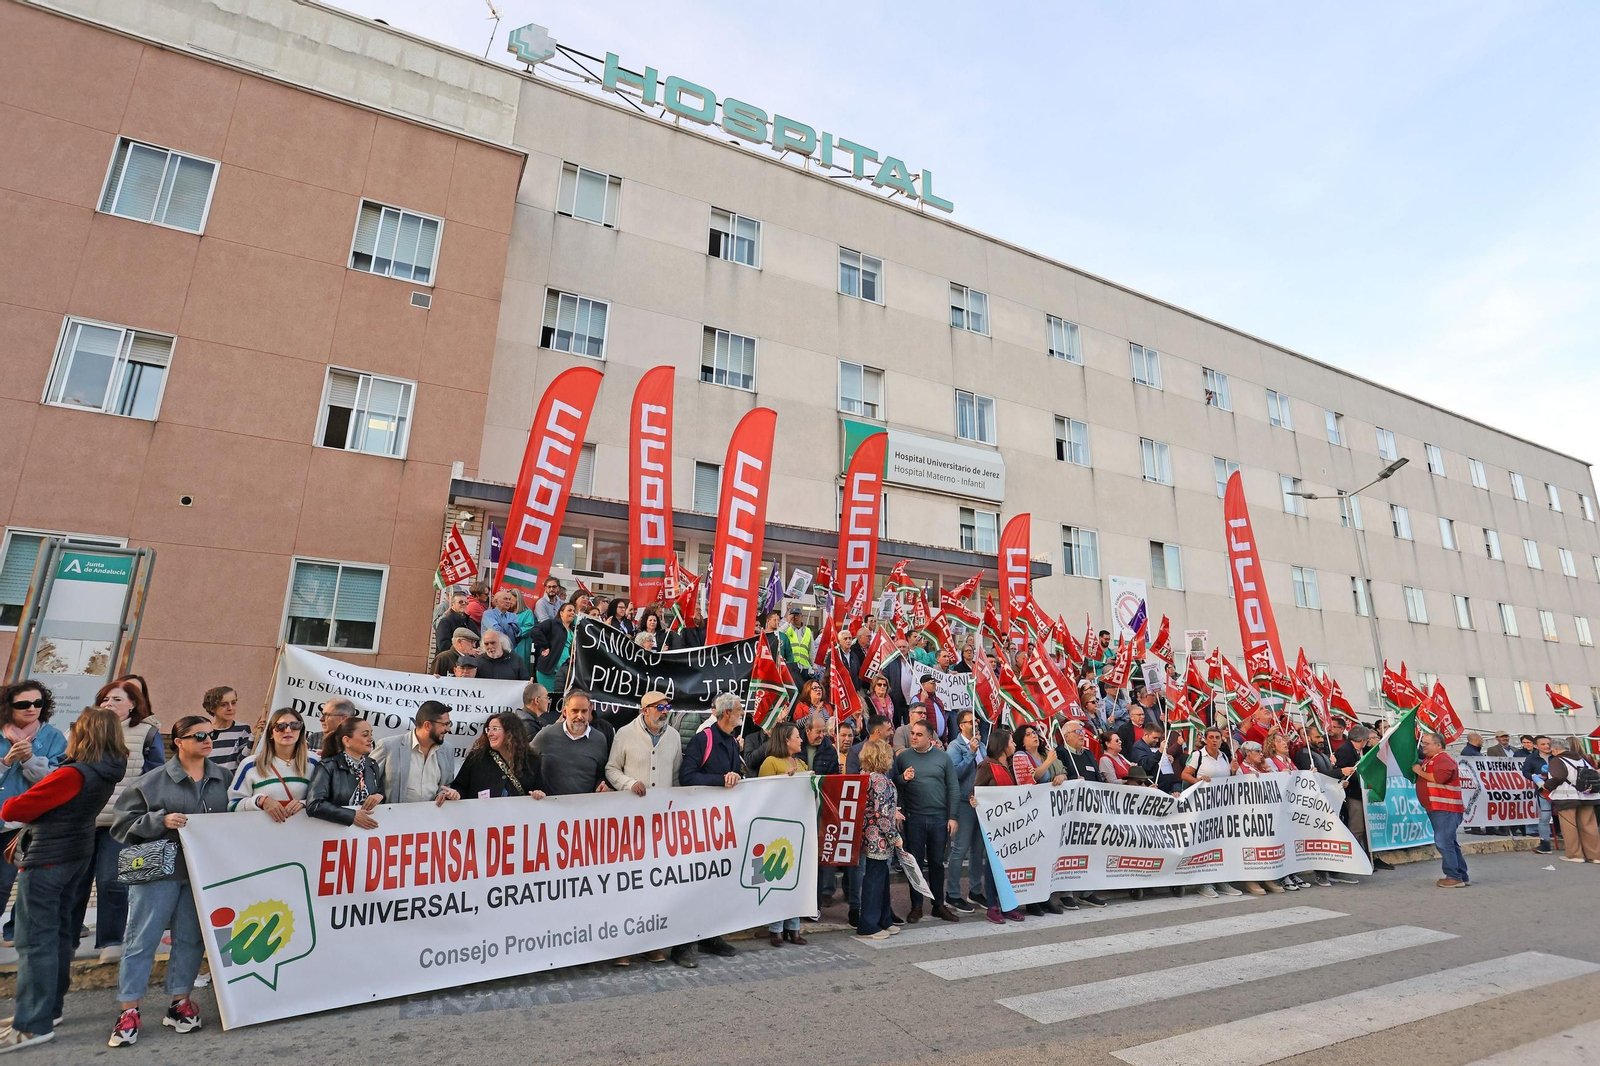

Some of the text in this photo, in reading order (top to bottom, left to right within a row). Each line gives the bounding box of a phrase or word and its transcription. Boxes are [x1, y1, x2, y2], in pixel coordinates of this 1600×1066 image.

[601, 52, 954, 214] HOSPITAL
[516, 398, 582, 556] CCOO
[640, 403, 666, 546] CCOO
[894, 451, 1000, 479] Hospital Universitario de Jerez
[894, 465, 925, 478] Hospital
[926, 470, 956, 483] Materno
[961, 477, 986, 489] Infantil
[716, 450, 762, 638] CCOO
[443, 556, 456, 582] Cádiz
[287, 676, 304, 689] DE
[308, 681, 373, 702] USUARIOS
[376, 695, 393, 707] DE
[456, 704, 472, 713] DE
[474, 705, 513, 714] SALUD
[328, 669, 485, 699] COORDINADORA VECINAL
[590, 664, 674, 700] PÚBLICA
[1295, 776, 1317, 791] POR
[1476, 761, 1485, 770] EN
[1488, 762, 1516, 771] DEFENSA
[986, 791, 1032, 821] POR LA
[1076, 787, 1121, 814] HOSPITAL
[1123, 792, 1140, 815] DE
[1194, 779, 1235, 811] ATENCIÓN
[1238, 780, 1282, 805] PRIMARIA
[1487, 792, 1510, 800] 100
[834, 780, 861, 863] CCOO
[1065, 808, 1275, 849] JEREZ COSTA NOROESTE Y SIERRA DE CÁDIZ
[1292, 812, 1334, 831] DEL SAS
[318, 800, 737, 896] EN DEFENSA DE LA SANIDAD PÚBLICA
[821, 824, 838, 862] Cádiz
[1191, 853, 1213, 863] CCOO
[1306, 842, 1339, 851] CCOO
[751, 843, 789, 885] iu
[1121, 858, 1153, 868] CCOO
[330, 858, 732, 929] UNIVERSAL, GRATUITA Y DE CALIDAD
[210, 906, 282, 968] iu
[419, 914, 668, 969] Consejo Provincial de Cádiz
